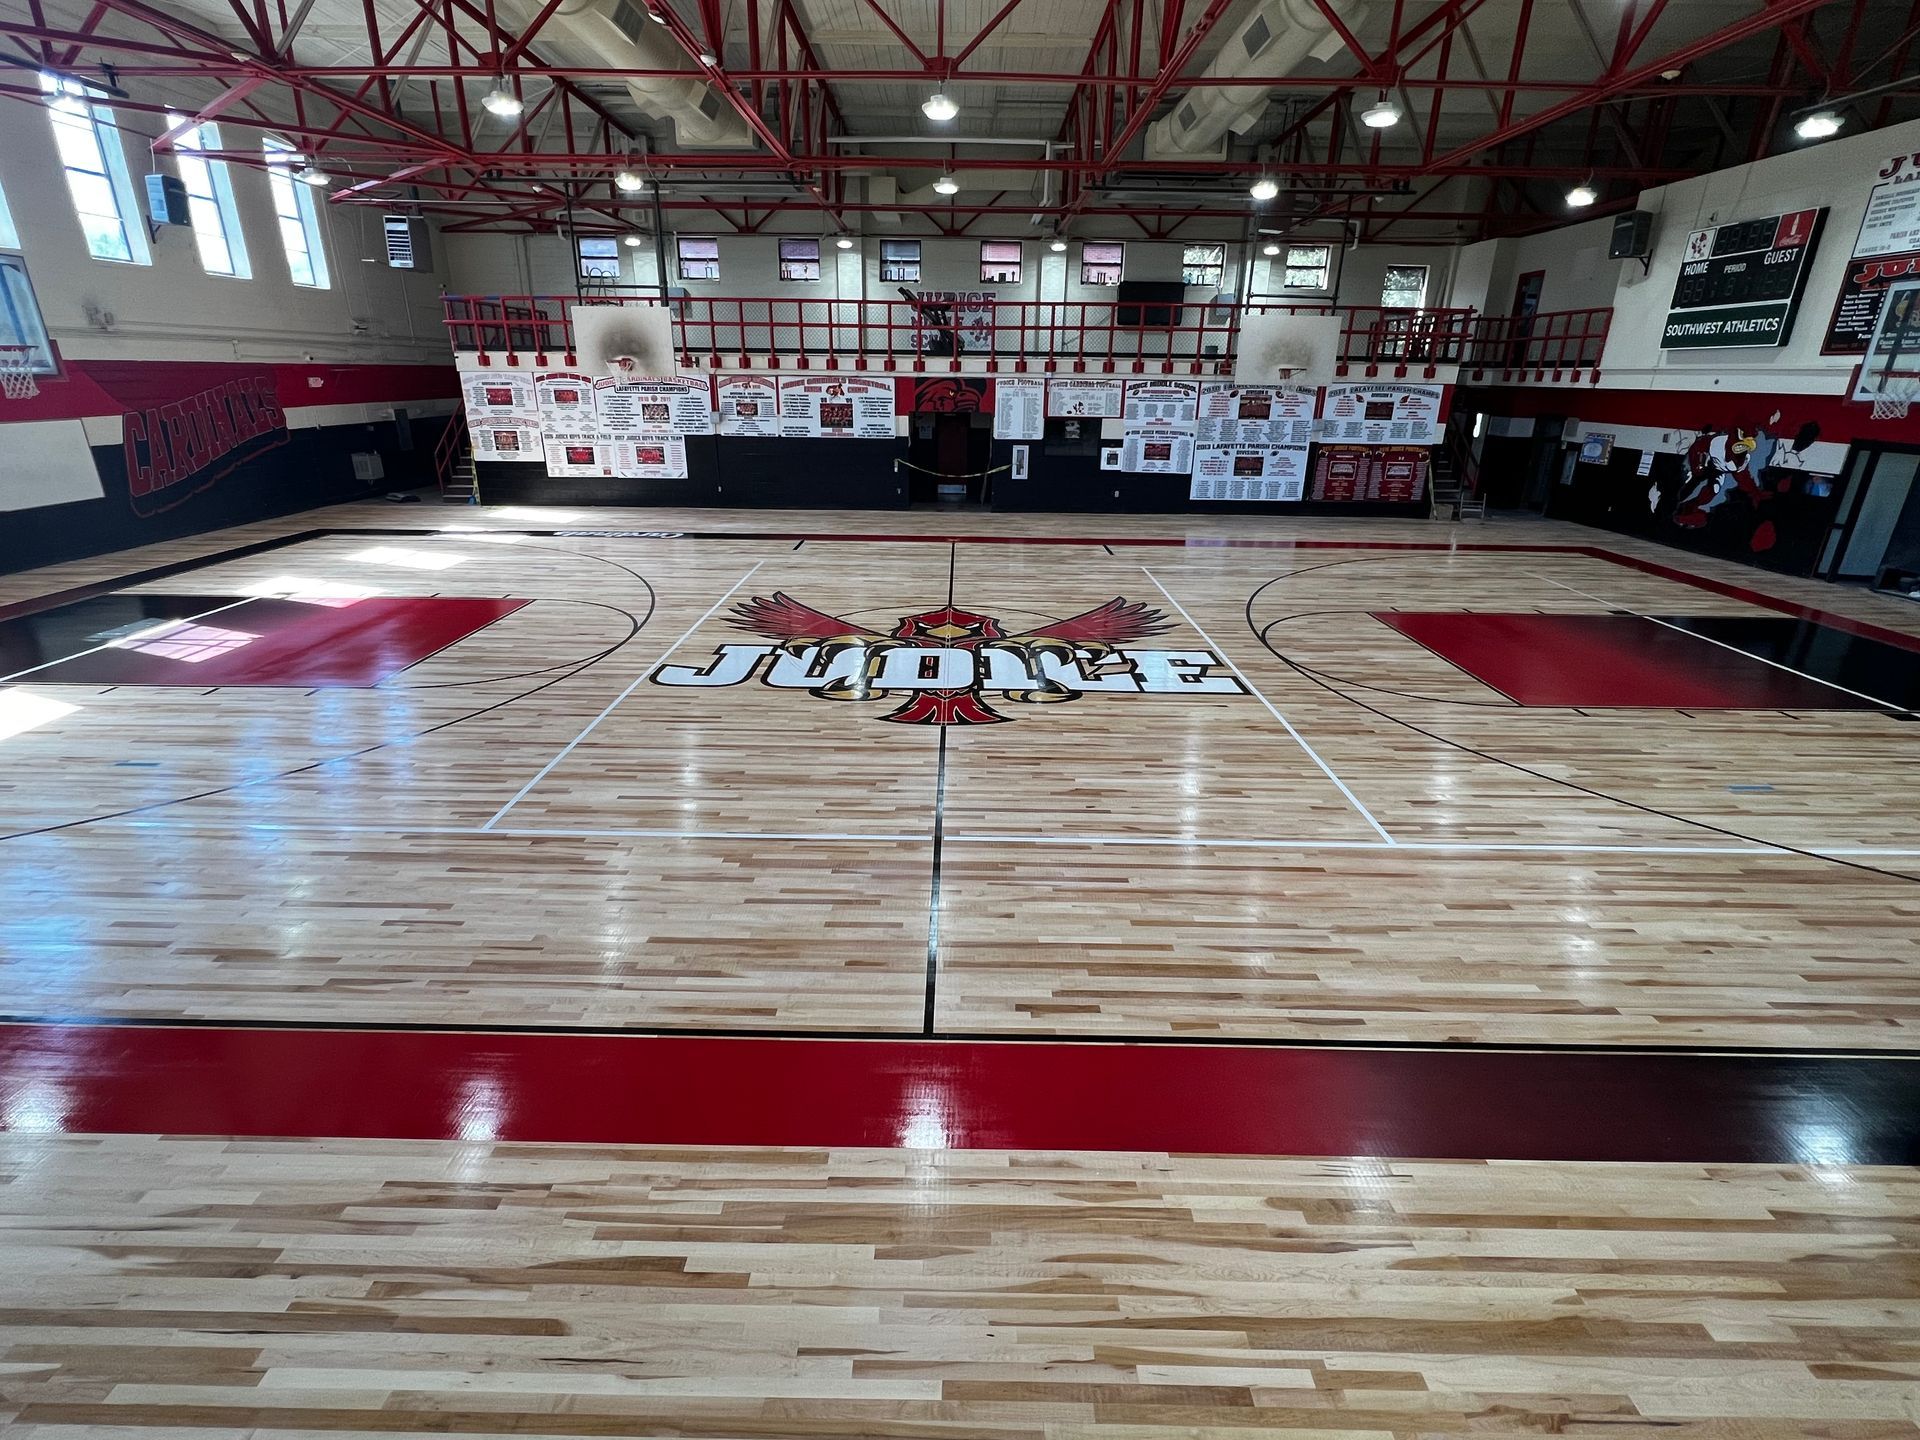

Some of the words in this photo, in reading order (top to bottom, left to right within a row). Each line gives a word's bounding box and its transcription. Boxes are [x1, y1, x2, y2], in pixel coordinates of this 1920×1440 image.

[1764, 248, 1799, 265] GUEST
[1684, 262, 1709, 276] HOME
[1723, 263, 1747, 274] PERIOD
[1666, 321, 1723, 336] SOUTHWEST
[1723, 317, 1780, 333] ATHLETICS
[663, 376, 707, 388] BASKETBALL
[1127, 382, 1148, 391] JUDICE
[1174, 382, 1197, 393] SCHOOL
[1387, 385, 1411, 393] PARISH
[1412, 387, 1440, 397] CHAMPS
[124, 377, 286, 497] CARDINALS
[649, 643, 1253, 695] JUDICE
